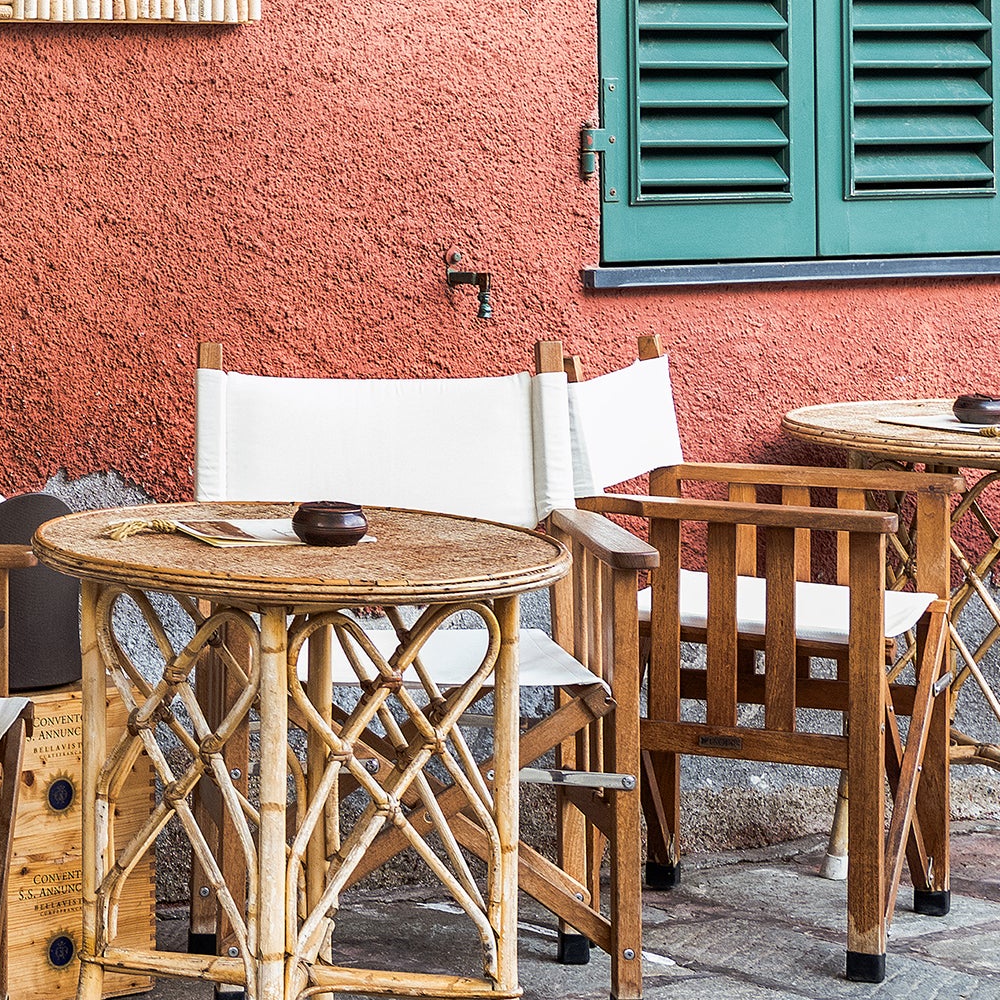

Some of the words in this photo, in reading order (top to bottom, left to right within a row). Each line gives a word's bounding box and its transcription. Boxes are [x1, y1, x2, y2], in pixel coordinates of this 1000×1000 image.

[38, 727, 81, 741] ANNUNC
[33, 742, 82, 754] BELLAVIST
[33, 869, 82, 885] CONVENT
[39, 883, 82, 898] ANNUNC
[34, 898, 82, 911] BELLAVIST
